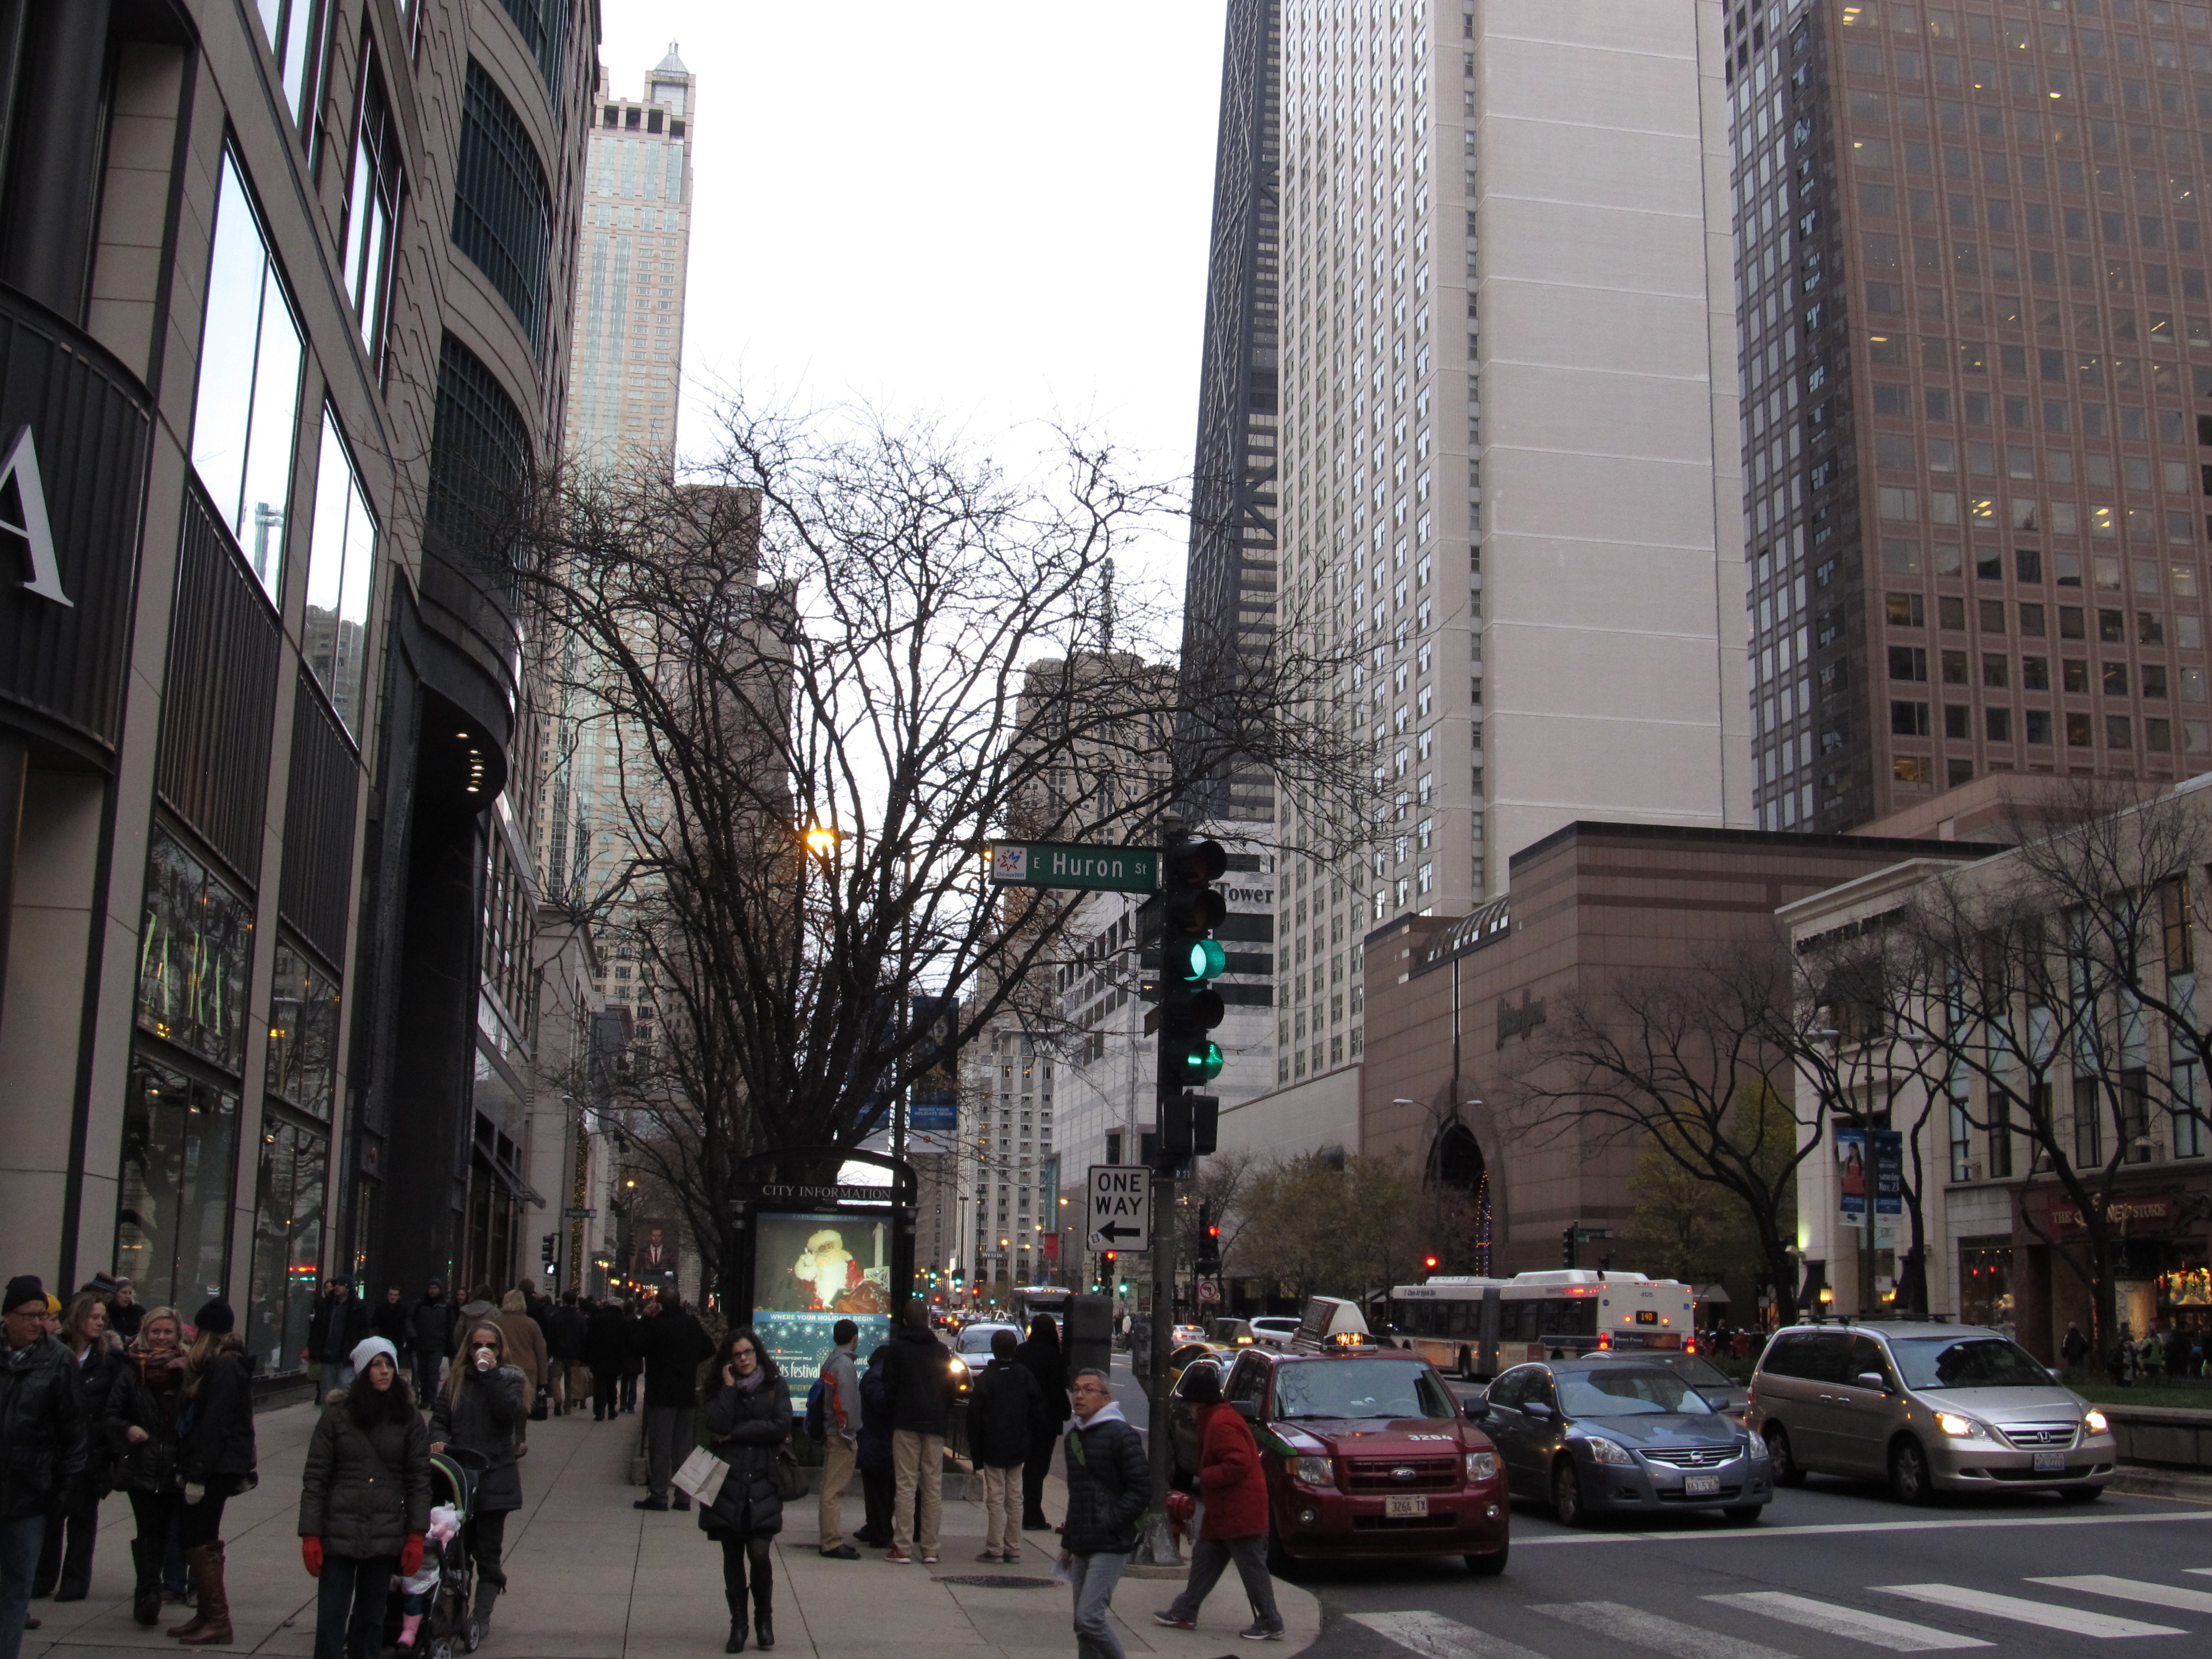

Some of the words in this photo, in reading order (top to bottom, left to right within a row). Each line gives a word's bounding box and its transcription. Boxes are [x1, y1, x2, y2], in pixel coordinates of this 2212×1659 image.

[1034, 857, 1040, 869] E
[1053, 852, 1123, 878] Huron
[1135, 863, 1147, 875] St
[1215, 882, 1274, 904] Tower
[1098, 1173, 1141, 1192] ONE
[1891, 1181, 1900, 1192] 23
[763, 1185, 795, 1196] CITY
[800, 1186, 891, 1199] INFORMATION
[1095, 1196, 1143, 1215] WAY
[2052, 1211, 2073, 1224] THE
[2133, 1203, 2167, 1218] STORE
[1337, 1332, 1363, 1345] 3264
[791, 1361, 821, 1378] festival
[1392, 1501, 1412, 1512] 3264
[1416, 1500, 1426, 1511] TX
